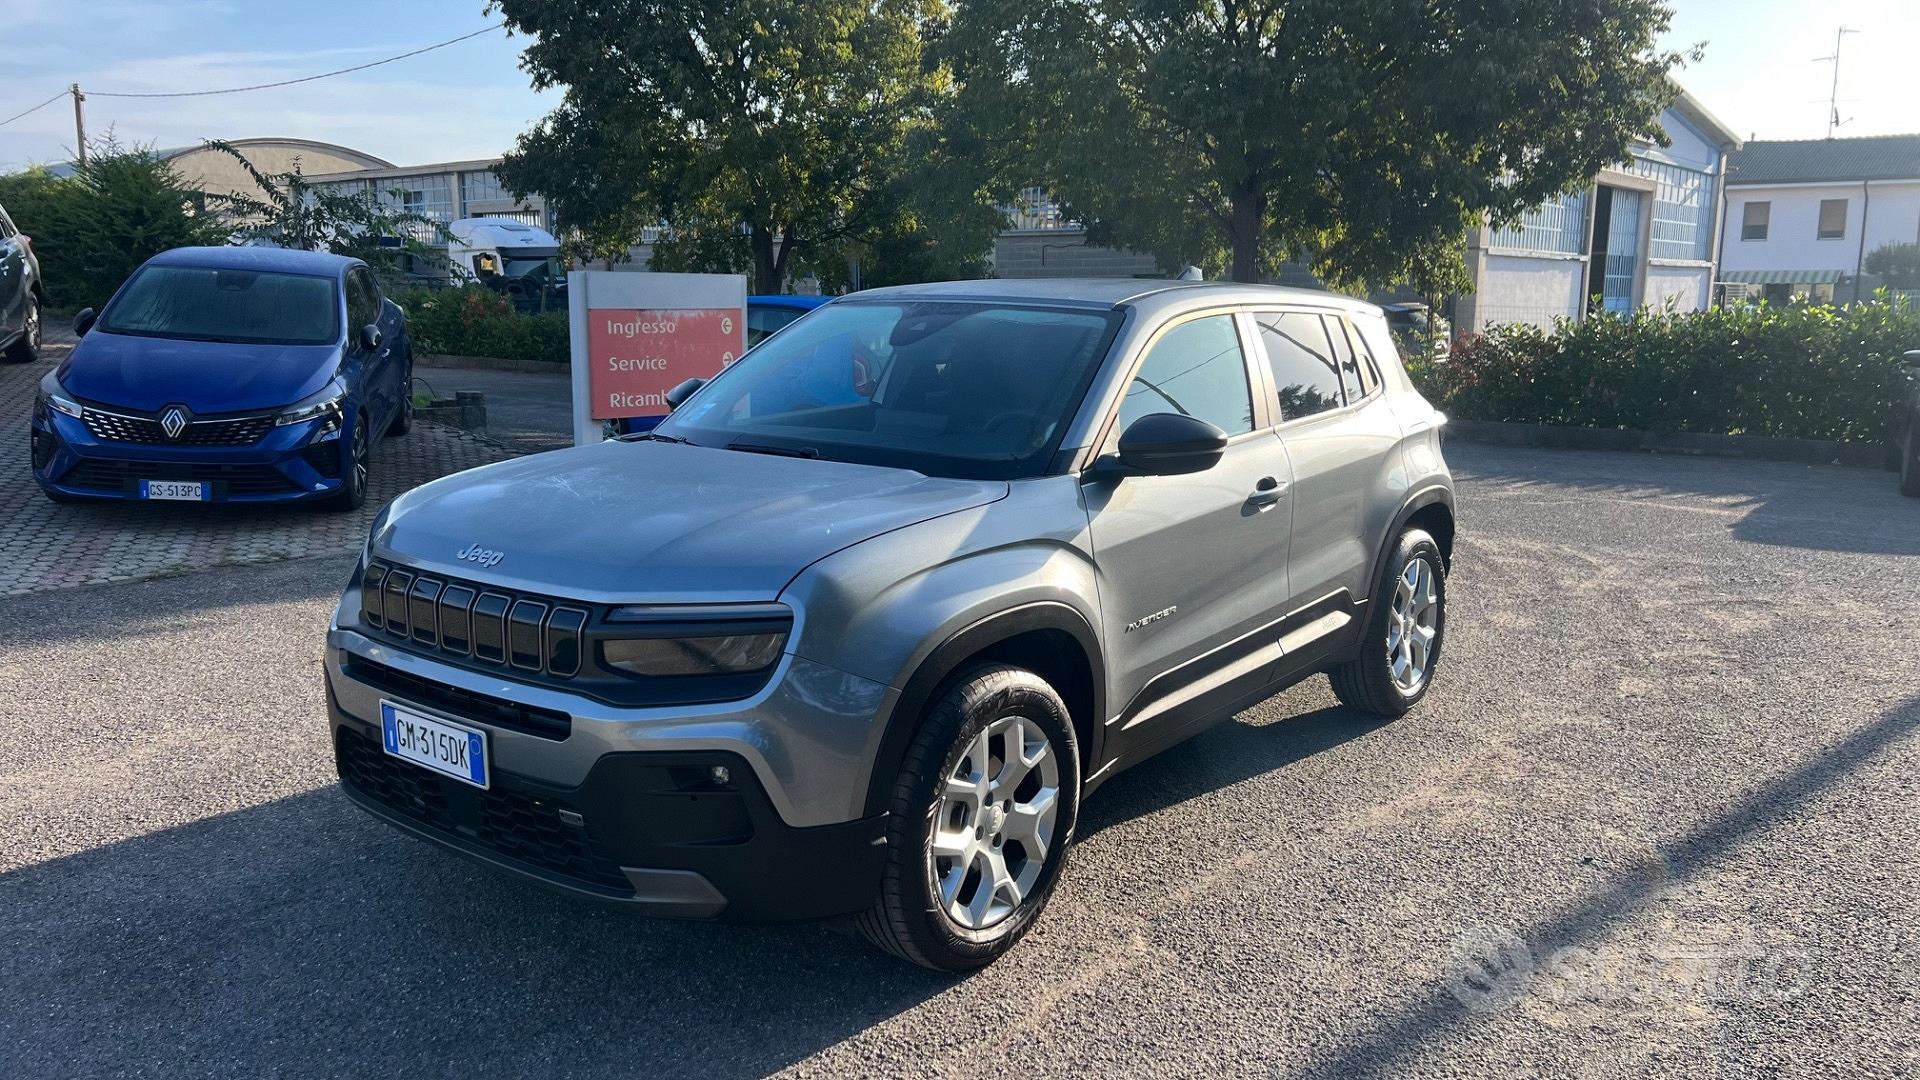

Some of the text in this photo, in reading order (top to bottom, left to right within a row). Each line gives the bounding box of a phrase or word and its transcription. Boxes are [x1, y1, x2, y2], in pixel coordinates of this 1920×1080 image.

[607, 319, 676, 338] Ingresso
[608, 355, 667, 371] Service
[456, 542, 505, 568] Jeep
